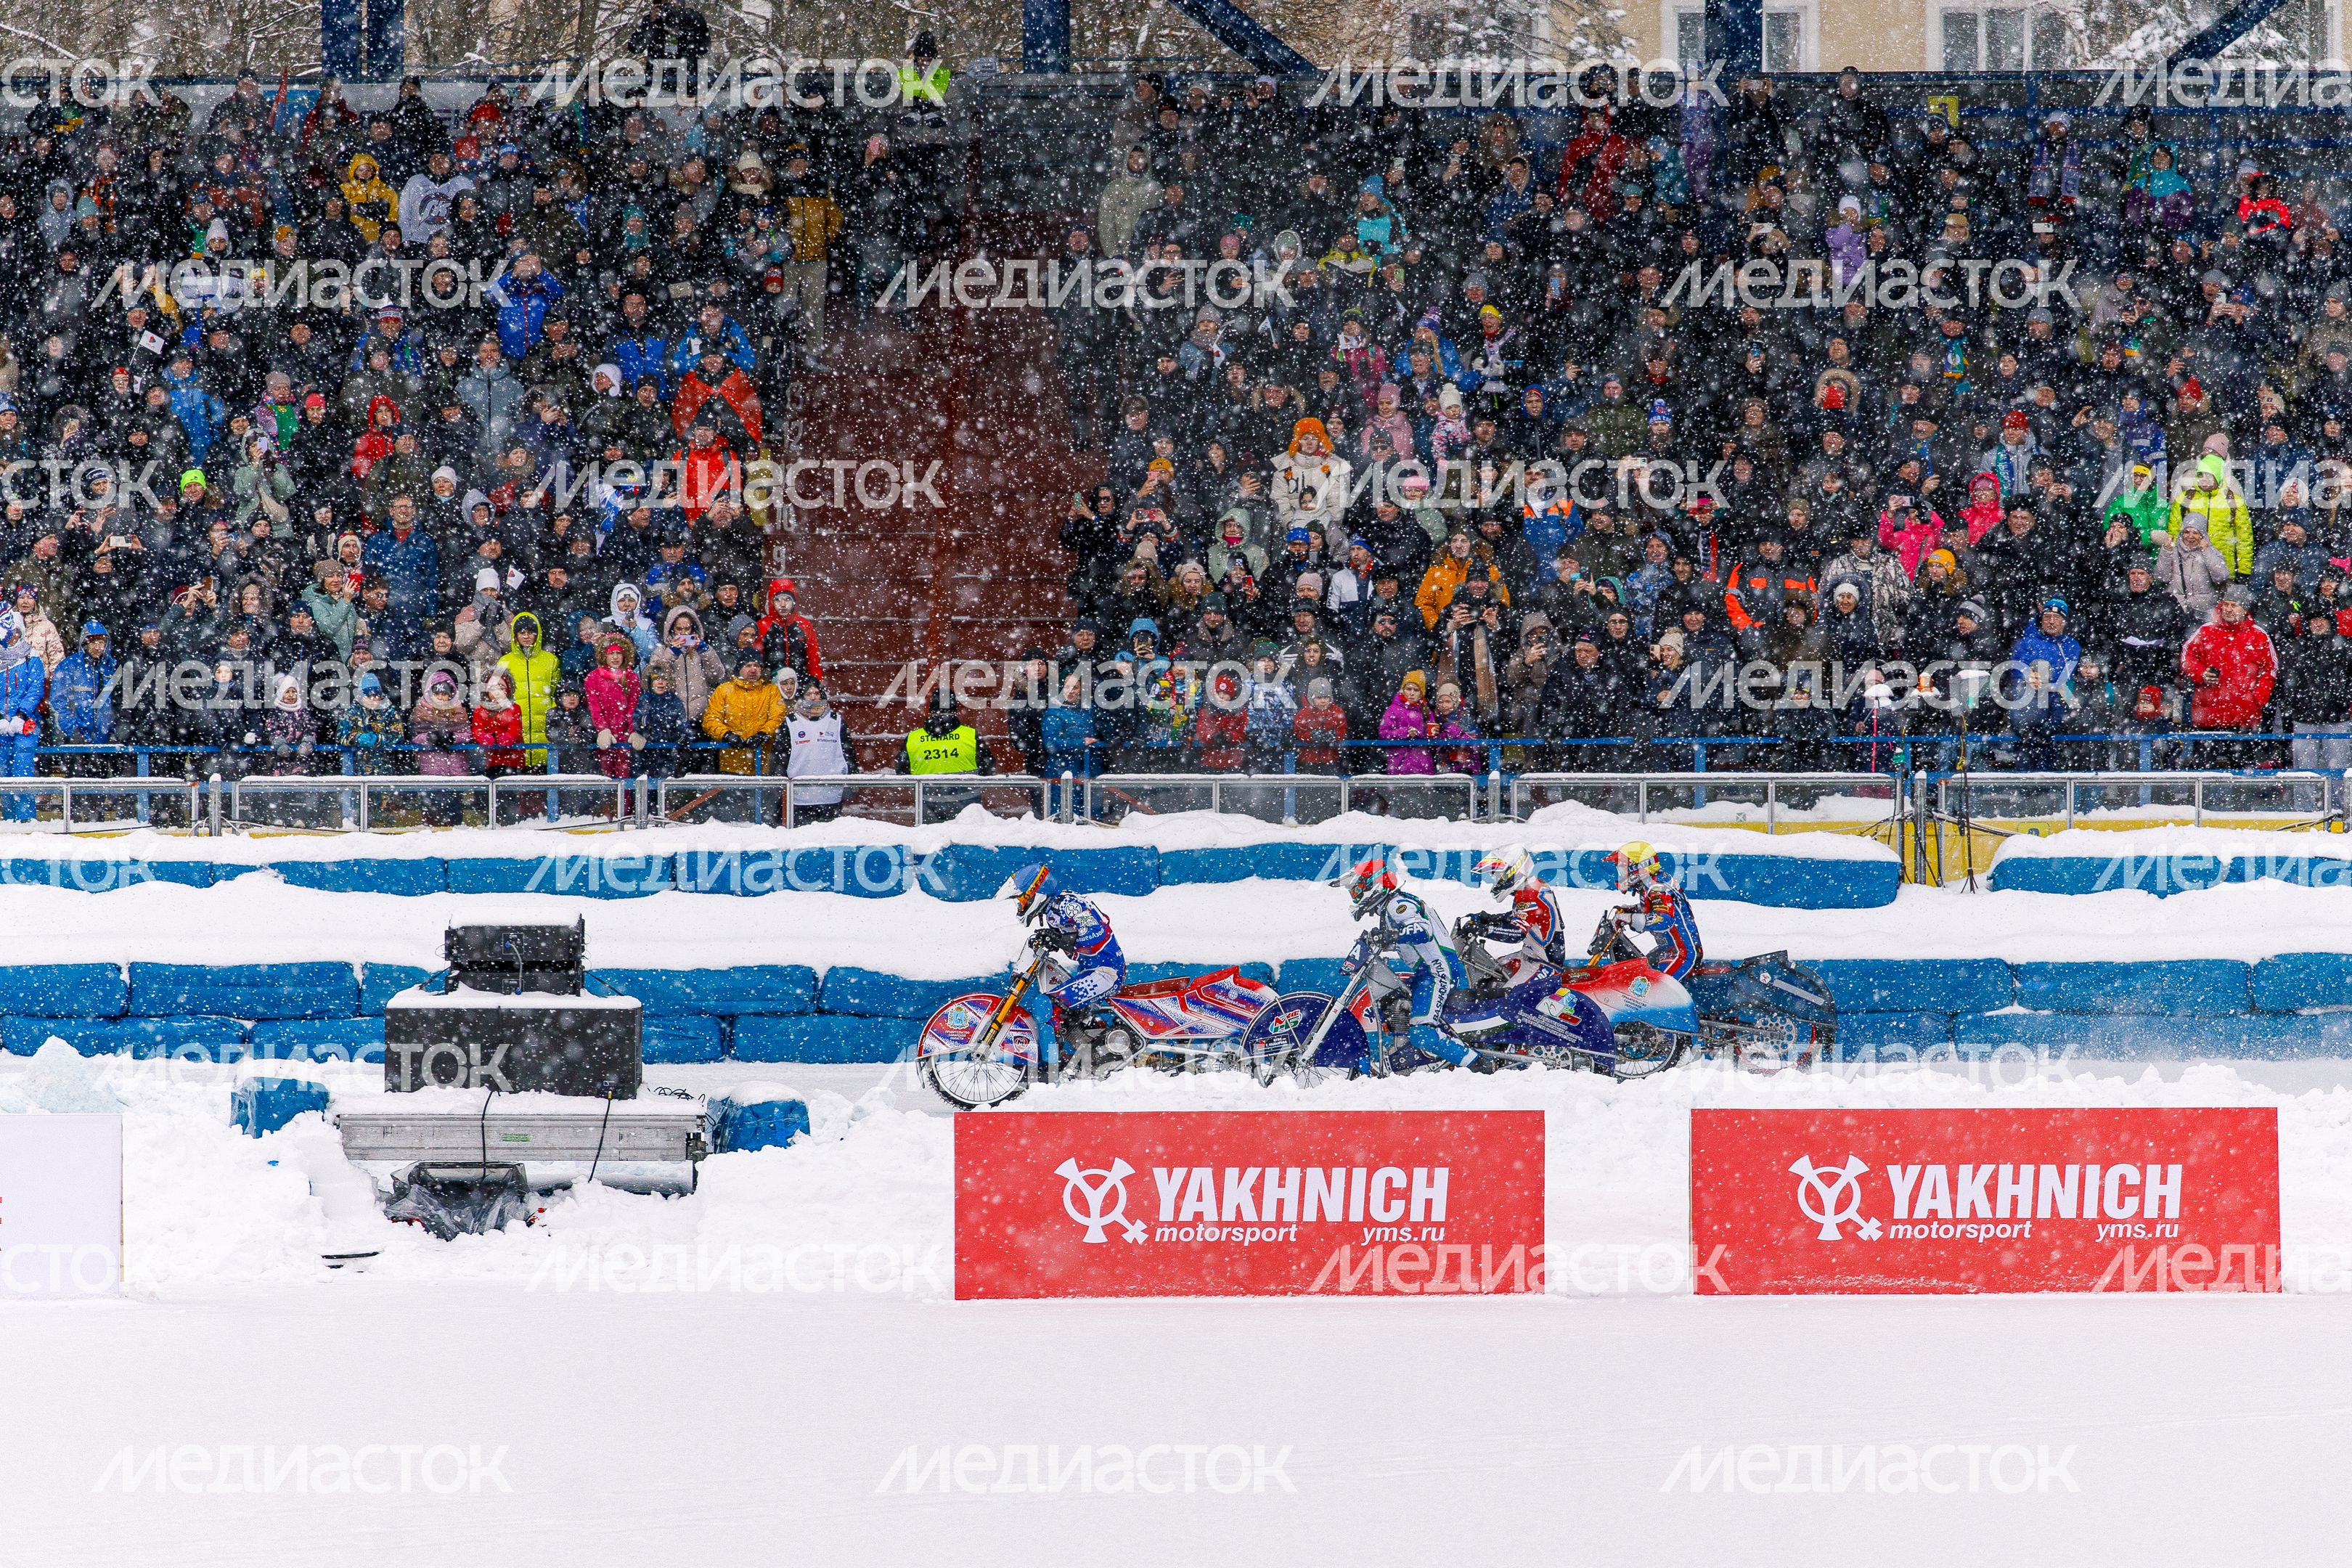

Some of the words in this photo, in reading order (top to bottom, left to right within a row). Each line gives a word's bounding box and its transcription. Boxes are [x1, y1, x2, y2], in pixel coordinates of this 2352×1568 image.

[772, 545, 786, 576] 9
[923, 748, 959, 761] 2314
[1152, 1166, 1450, 1222] YAKHNICH
[1887, 1163, 2183, 1220] YAKHNICH
[1154, 1223, 1299, 1246] motorsport
[1360, 1225, 1445, 1247] yms.ru
[1889, 1220, 2033, 1243] motorsport
[2094, 1222, 2179, 1243] yms.ru
